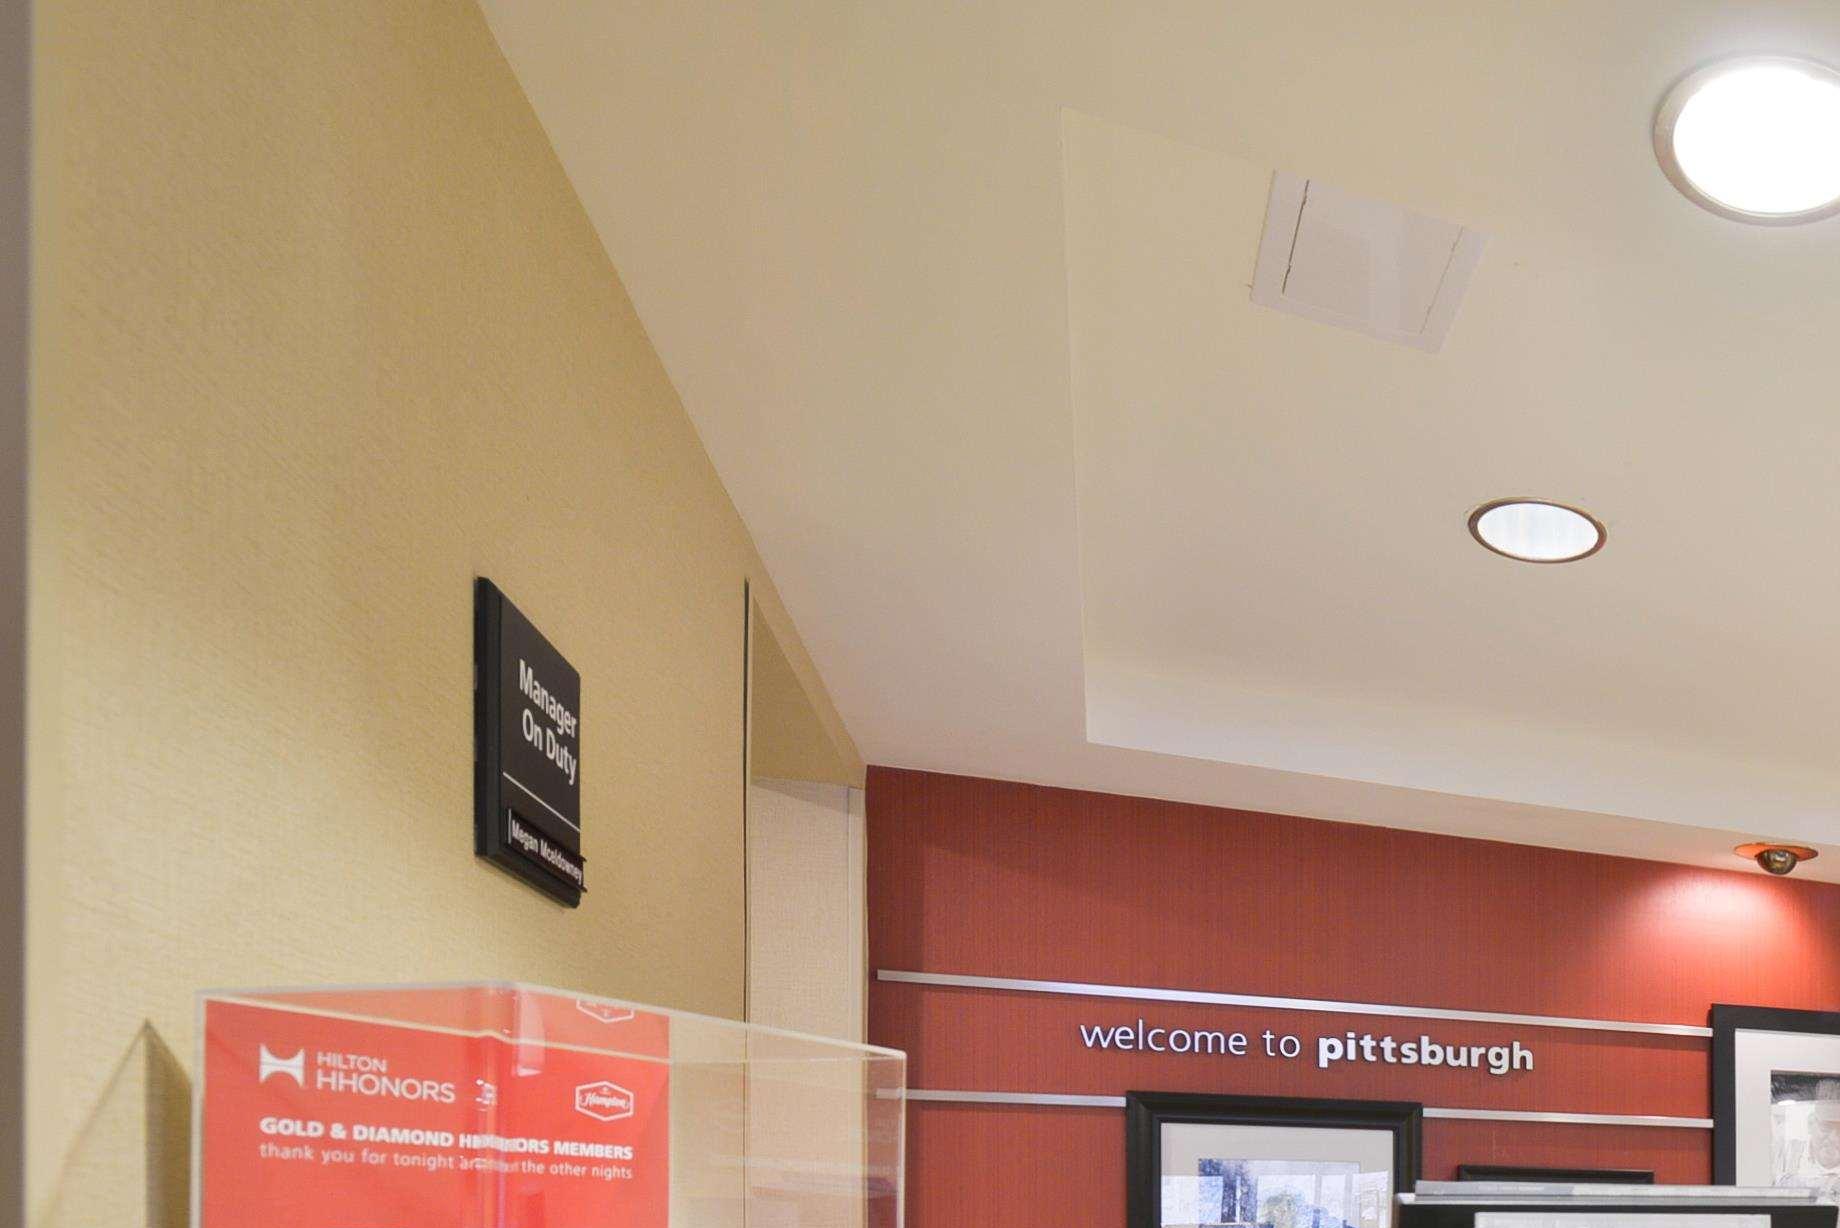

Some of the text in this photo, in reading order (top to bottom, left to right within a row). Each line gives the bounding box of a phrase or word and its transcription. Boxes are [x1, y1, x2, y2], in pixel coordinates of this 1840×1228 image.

[519, 658, 577, 738] Manager
[522, 708, 577, 786] On Duty
[512, 819, 538, 854] Megan
[316, 1051, 387, 1073] HILTON
[1080, 1018, 1534, 1075] welcome to pittsburgh
[316, 1068, 456, 1104] HHONORS
[259, 1116, 324, 1138] GOLD
[329, 1122, 347, 1140] &
[352, 1124, 454, 1148] DIAMOND
[553, 1140, 634, 1160] MEMBERS
[259, 1142, 314, 1161] thank
[321, 1149, 355, 1165] you
[361, 1147, 387, 1165] for
[393, 1152, 454, 1172] tonight
[521, 1160, 545, 1175] the
[549, 1161, 587, 1177] other
[591, 1163, 634, 1182] nights
